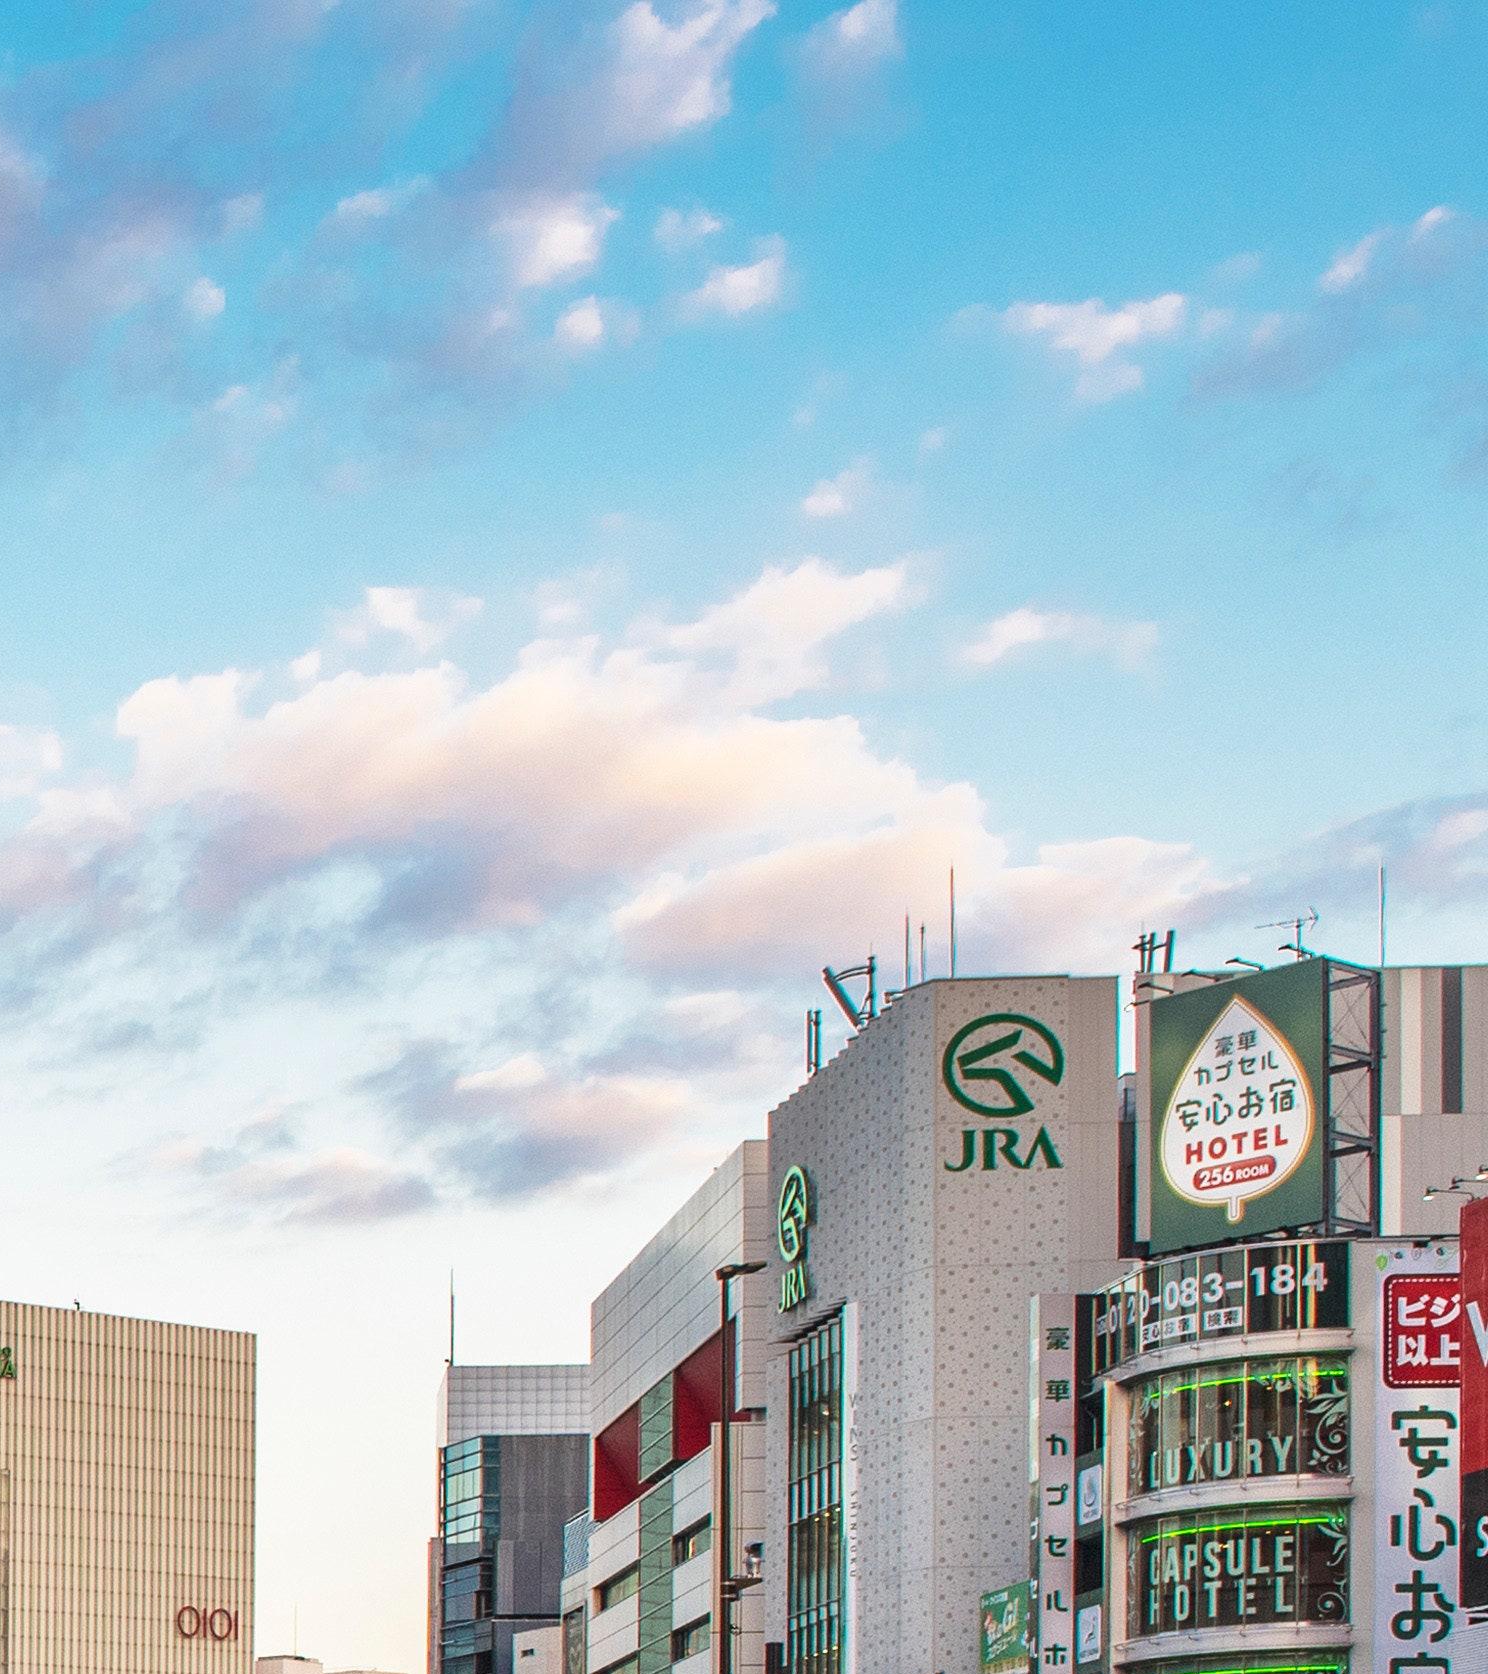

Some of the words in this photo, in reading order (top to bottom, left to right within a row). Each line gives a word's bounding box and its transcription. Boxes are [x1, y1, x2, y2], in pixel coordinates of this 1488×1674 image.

[1216, 1031, 1258, 1057] 豪華
[1194, 1052, 1277, 1085] カプセル
[1175, 1077, 1296, 1128] 安心お宿
[944, 1128, 1063, 1173] JRA
[1185, 1125, 1289, 1164] HOTEL
[1201, 1163, 1234, 1187] 256
[1236, 1162, 1270, 1181] ROOM
[779, 1262, 806, 1315] JRA
[1150, 1437, 1293, 1488] LUXURY
[1150, 1537, 1294, 1584] CAPSULE
[1150, 1578, 1293, 1624] HOTEL
